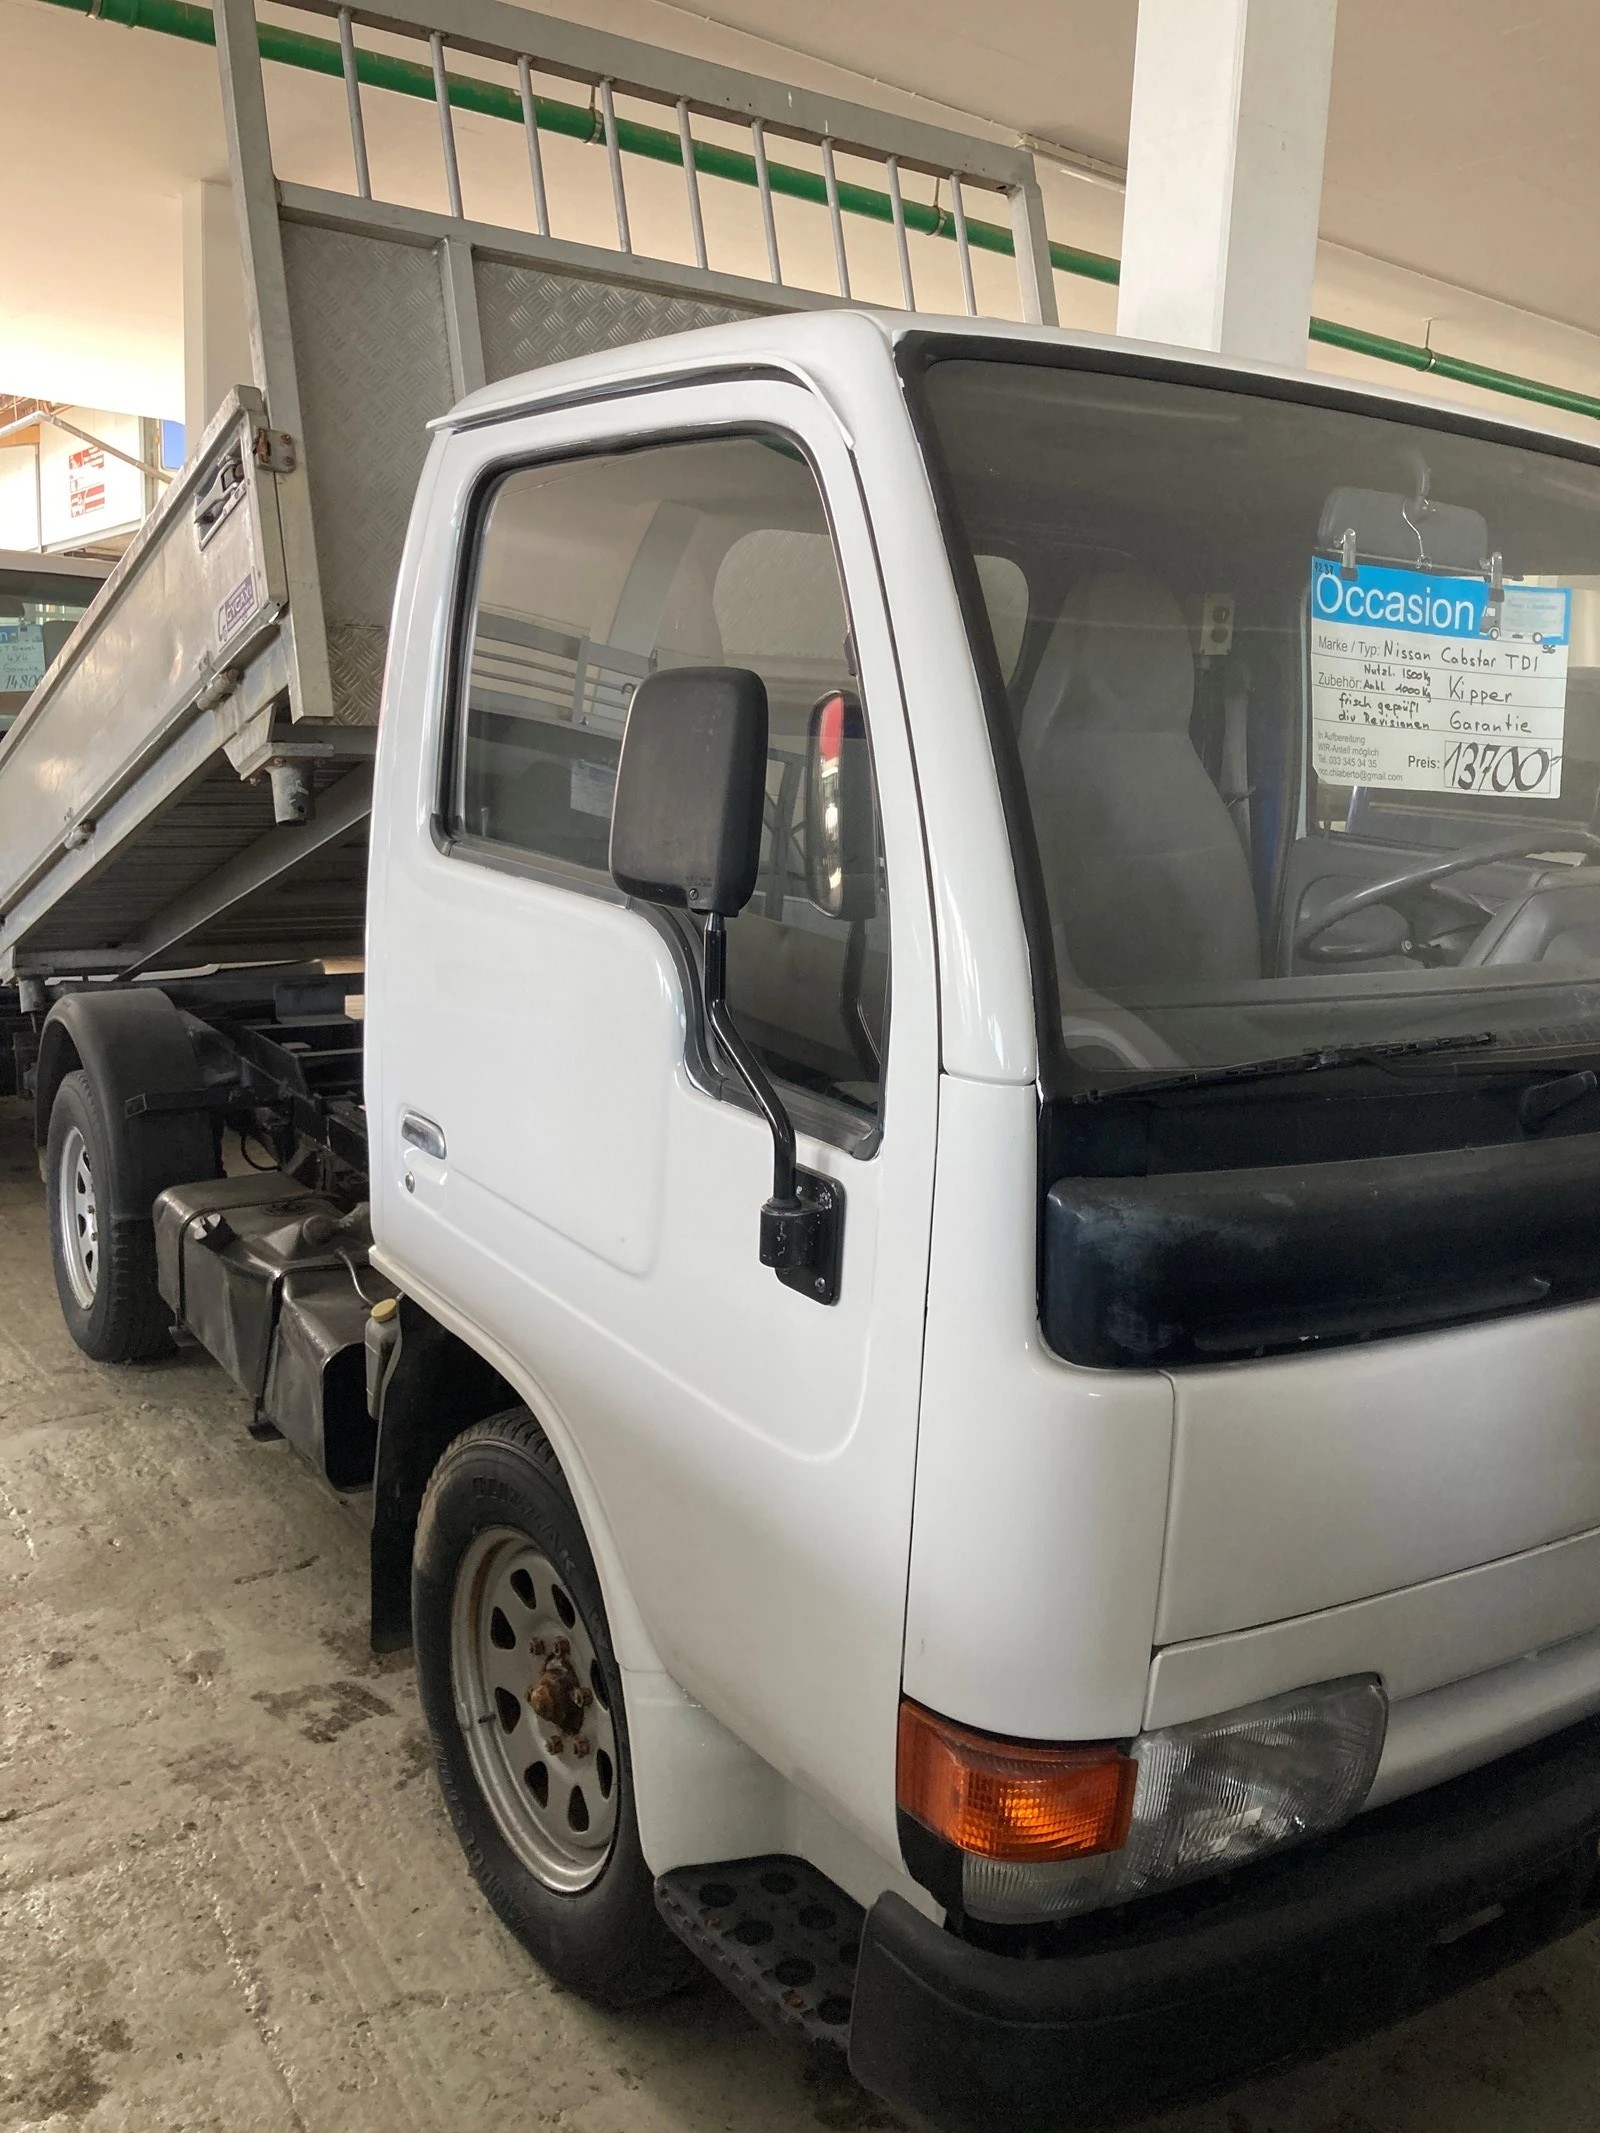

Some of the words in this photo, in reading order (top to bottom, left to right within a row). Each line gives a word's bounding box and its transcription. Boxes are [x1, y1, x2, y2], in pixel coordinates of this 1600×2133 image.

[1316, 573, 1474, 631] Occasion
[1318, 636, 1348, 653] Marke
[1358, 641, 1381, 658] Typ:
[1383, 640, 1432, 661] Nissan
[1440, 646, 1497, 668] Cabstar
[1318, 671, 1362, 690] Zubehör:
[1448, 675, 1513, 706] Kipper
[1338, 692, 1372, 708] frisch
[1338, 709, 1356, 722] div
[1449, 710, 1532, 733] Garantie
[1407, 755, 1440, 770] Preis:
